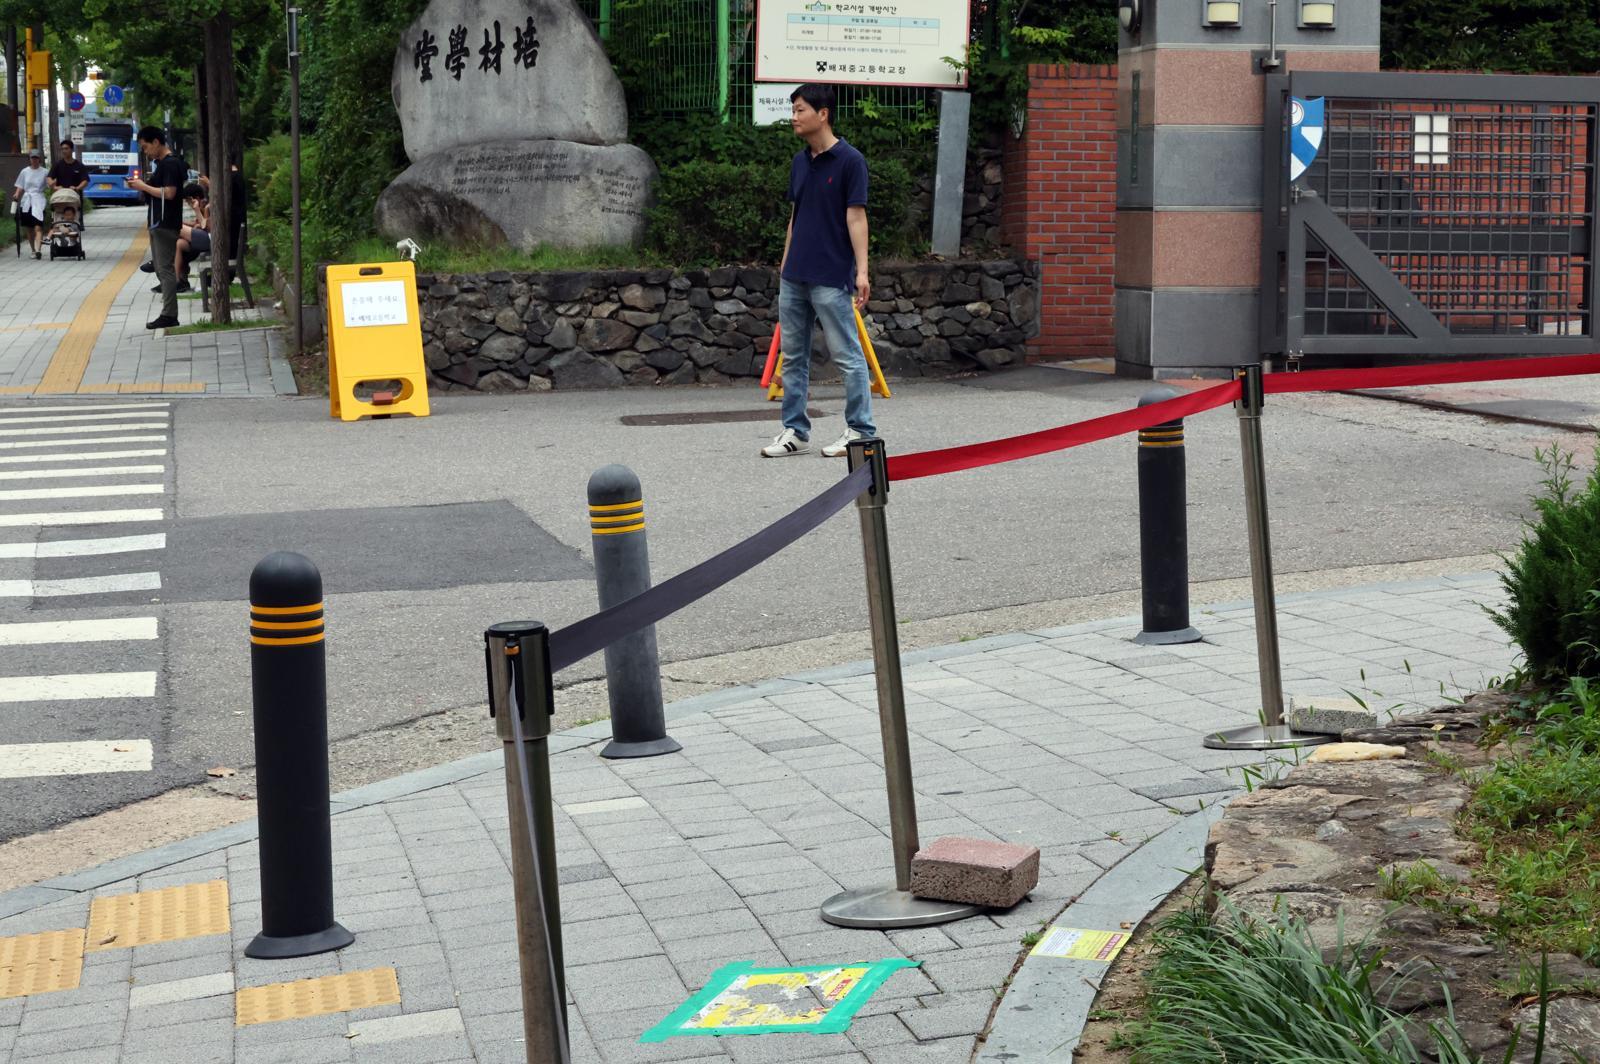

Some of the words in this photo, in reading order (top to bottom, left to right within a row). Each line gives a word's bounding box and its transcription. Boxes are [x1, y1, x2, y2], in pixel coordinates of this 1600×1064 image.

[836, 4, 864, 14] 학교시설
[868, 5, 897, 15] 개방시간
[829, 64, 906, 75] 배재중고등학교장
